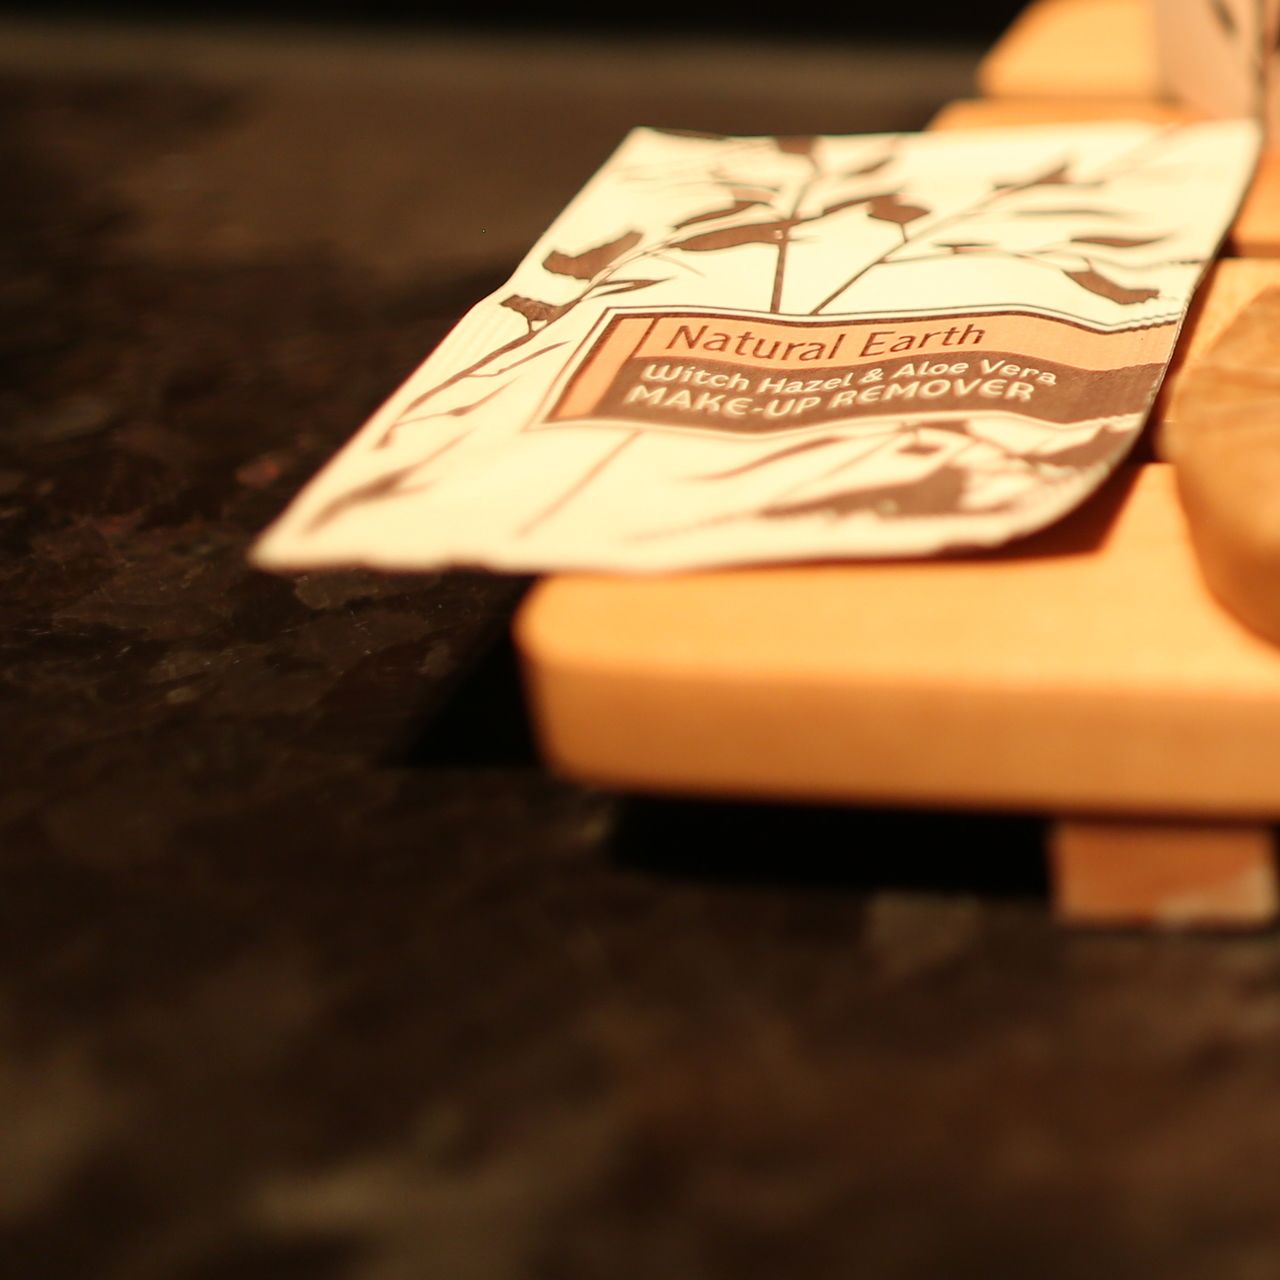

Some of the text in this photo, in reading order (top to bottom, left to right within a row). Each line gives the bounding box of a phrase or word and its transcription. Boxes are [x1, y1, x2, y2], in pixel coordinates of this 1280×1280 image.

[666, 323, 986, 361] Natural Earth
[641, 358, 1057, 394] Witch Hazel & Aloe Vera
[624, 377, 1036, 419] MAKE-UP REMOVER
